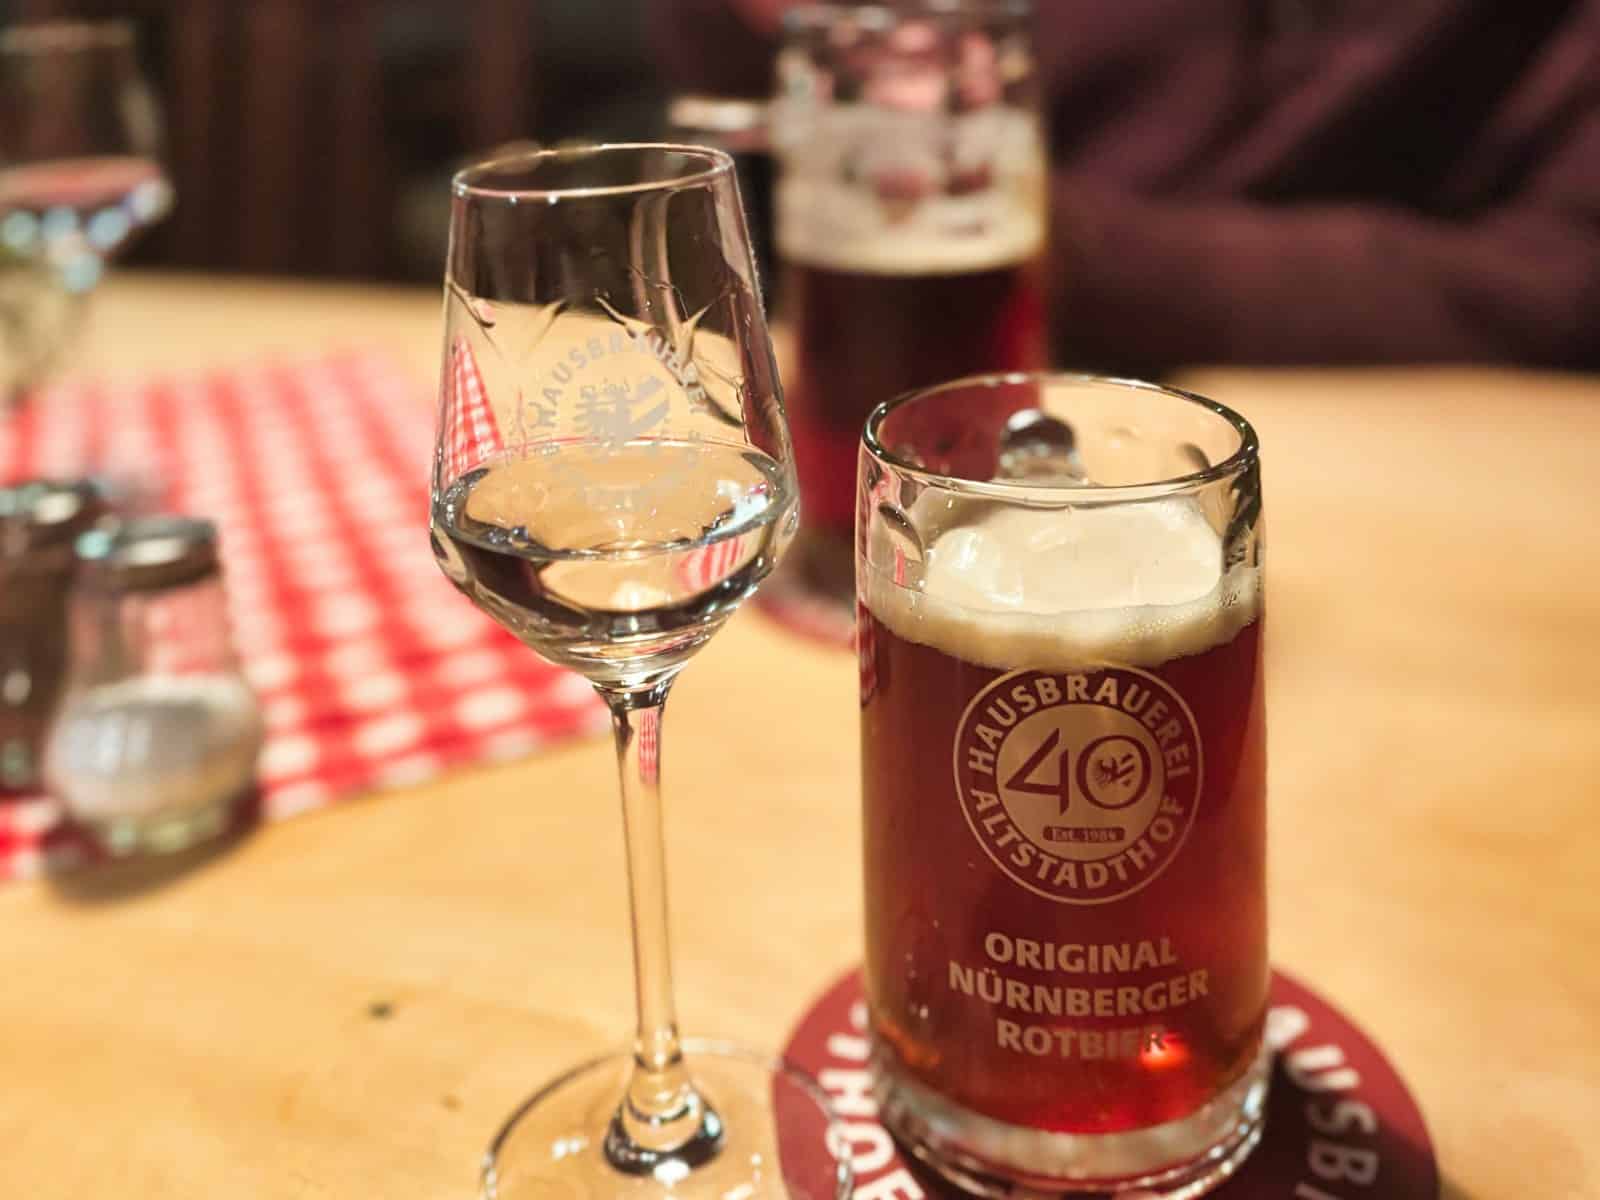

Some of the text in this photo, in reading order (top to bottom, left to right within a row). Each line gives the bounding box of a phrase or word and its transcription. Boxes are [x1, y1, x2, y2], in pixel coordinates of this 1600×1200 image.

[967, 674, 1191, 780] HAUSBRAUEREI
[1004, 727, 1153, 816] 40
[970, 788, 1185, 889] ALTSTADTHOF
[949, 959, 1209, 1017] NÜRNBERGER
[984, 932, 1178, 974] ORIGINAL
[996, 1018, 1167, 1060] ROTBIER
